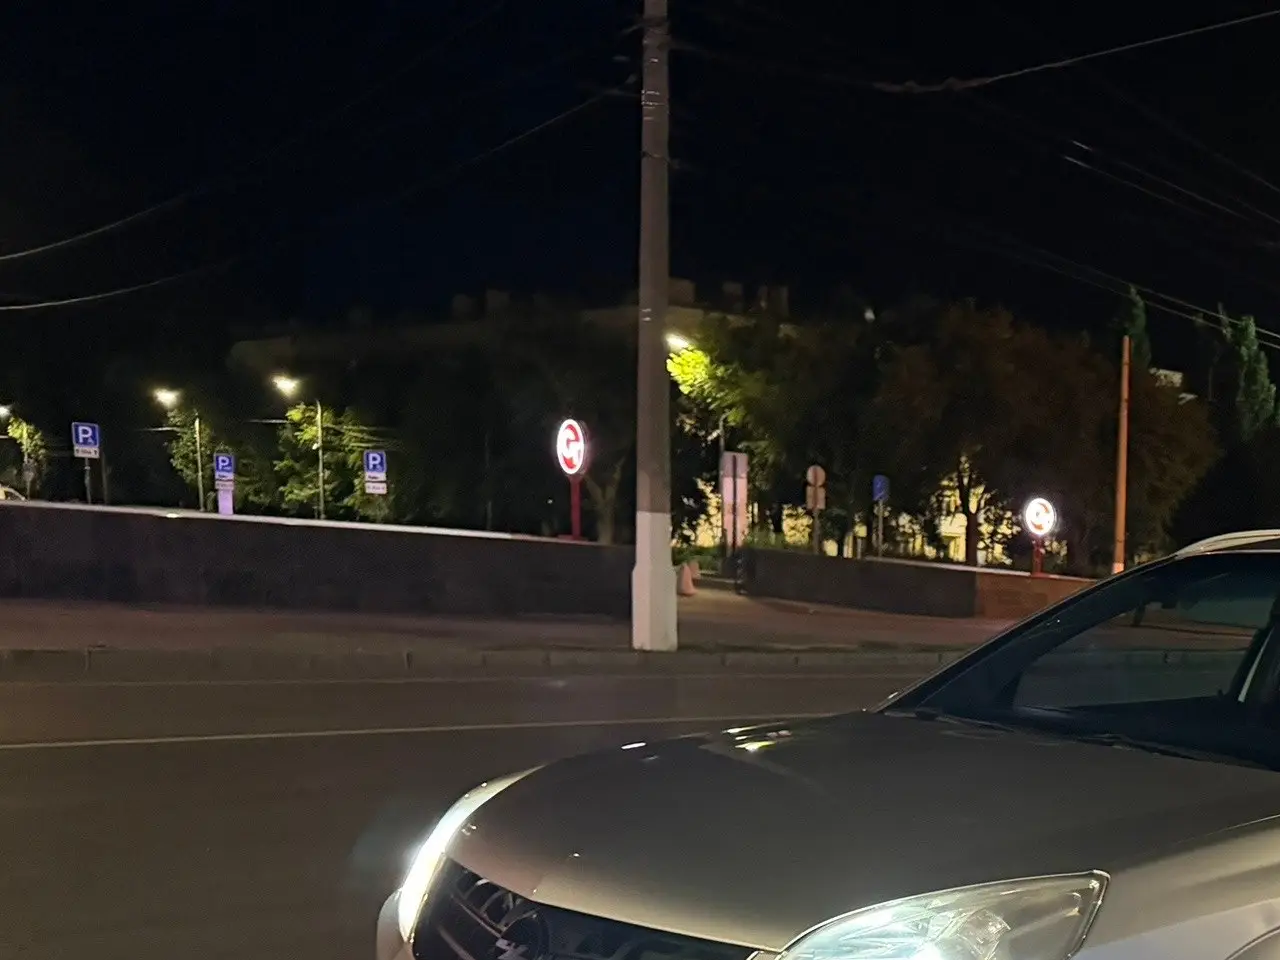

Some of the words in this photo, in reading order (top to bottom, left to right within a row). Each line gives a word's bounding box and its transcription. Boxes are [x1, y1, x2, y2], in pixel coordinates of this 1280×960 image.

[78, 425, 92, 443] P
[218, 455, 230, 470] P
[367, 453, 381, 470] P
